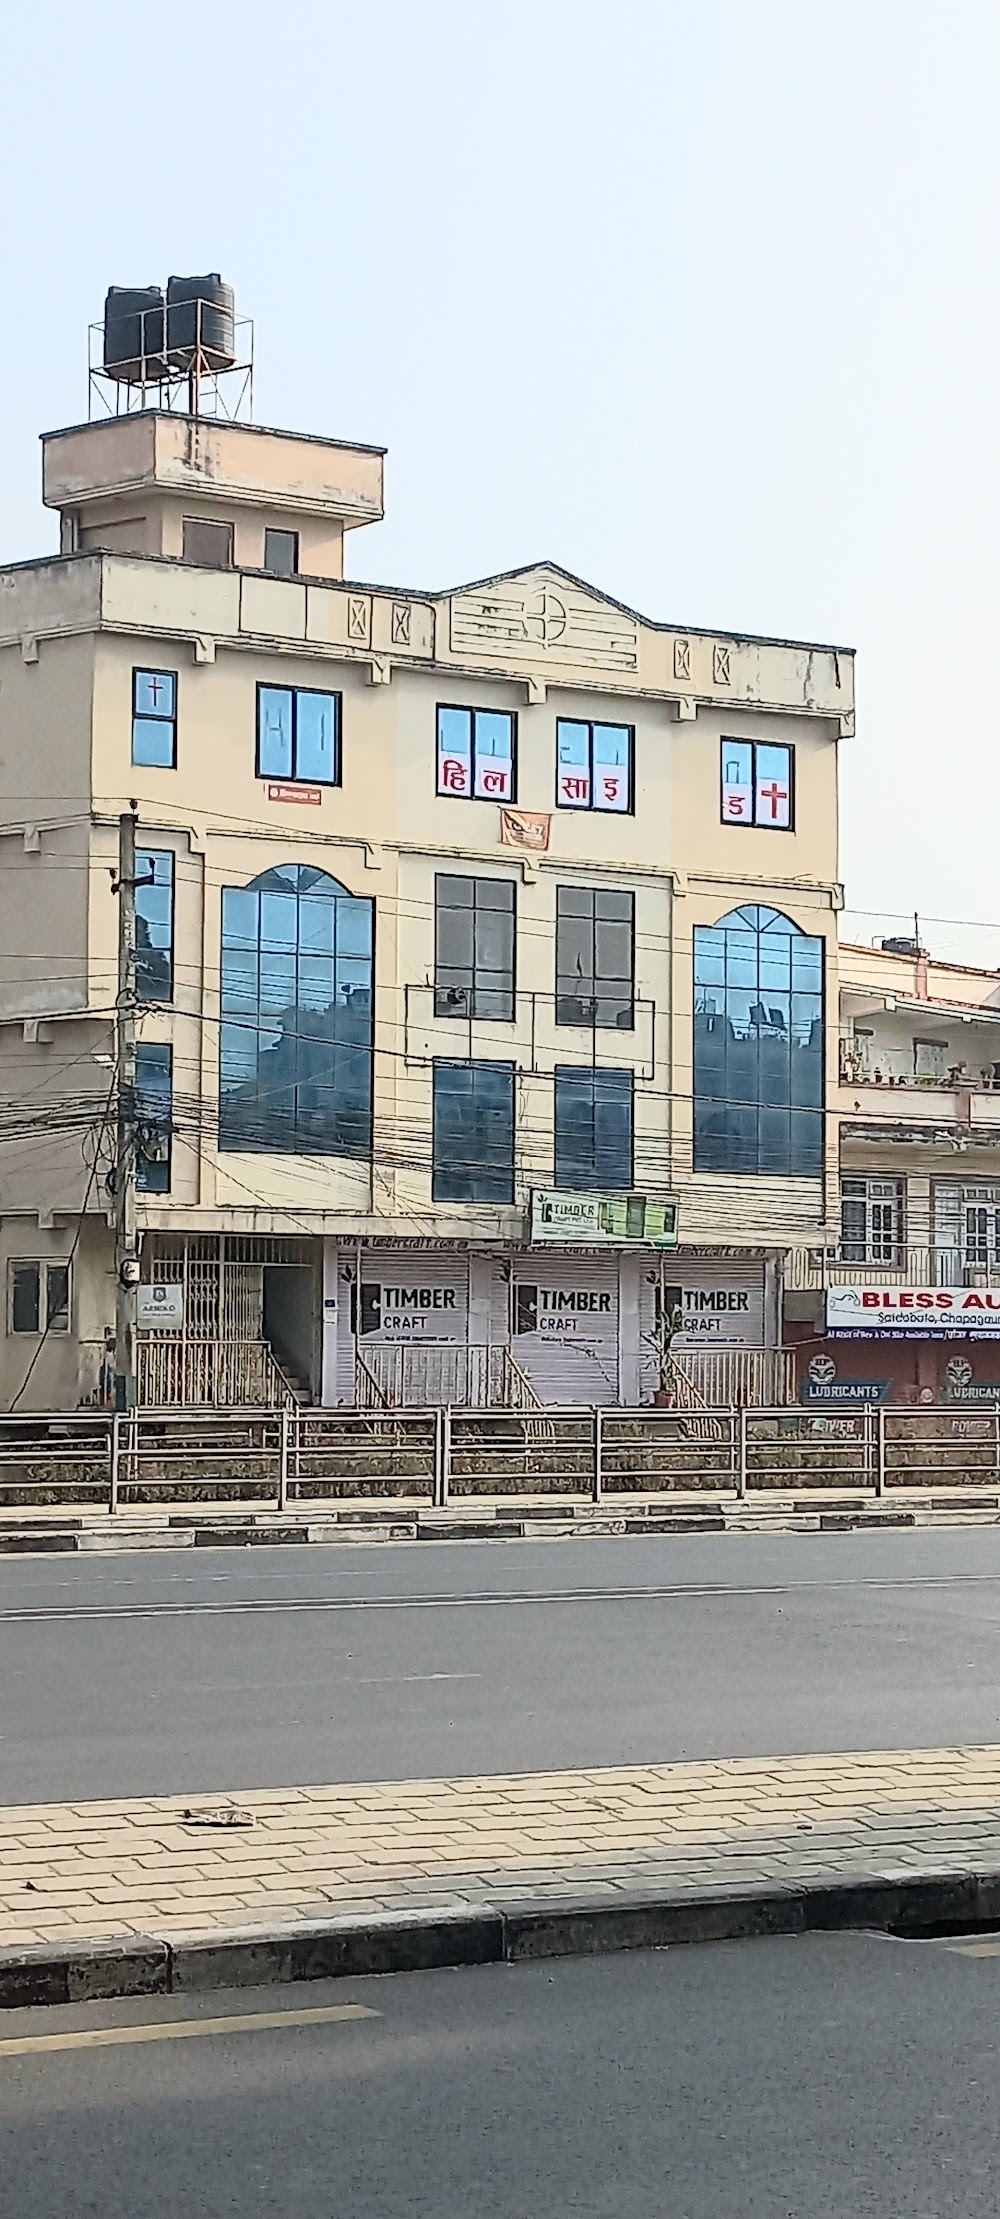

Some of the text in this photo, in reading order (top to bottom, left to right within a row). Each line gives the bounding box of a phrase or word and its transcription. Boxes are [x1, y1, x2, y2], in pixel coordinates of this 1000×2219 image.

[554, 1203, 595, 1216] TIMBER
[383, 1288, 456, 1309] TIMBER
[540, 1290, 611, 1312] TIMBER
[683, 1291, 749, 1311] TIMBER
[862, 1292, 1000, 1309] BLESS AU
[383, 1316, 427, 1329] CRAFT
[539, 1317, 577, 1331] CRAFT
[683, 1318, 721, 1331] CRAFT
[809, 1385, 879, 1398] LUBRICANTS
